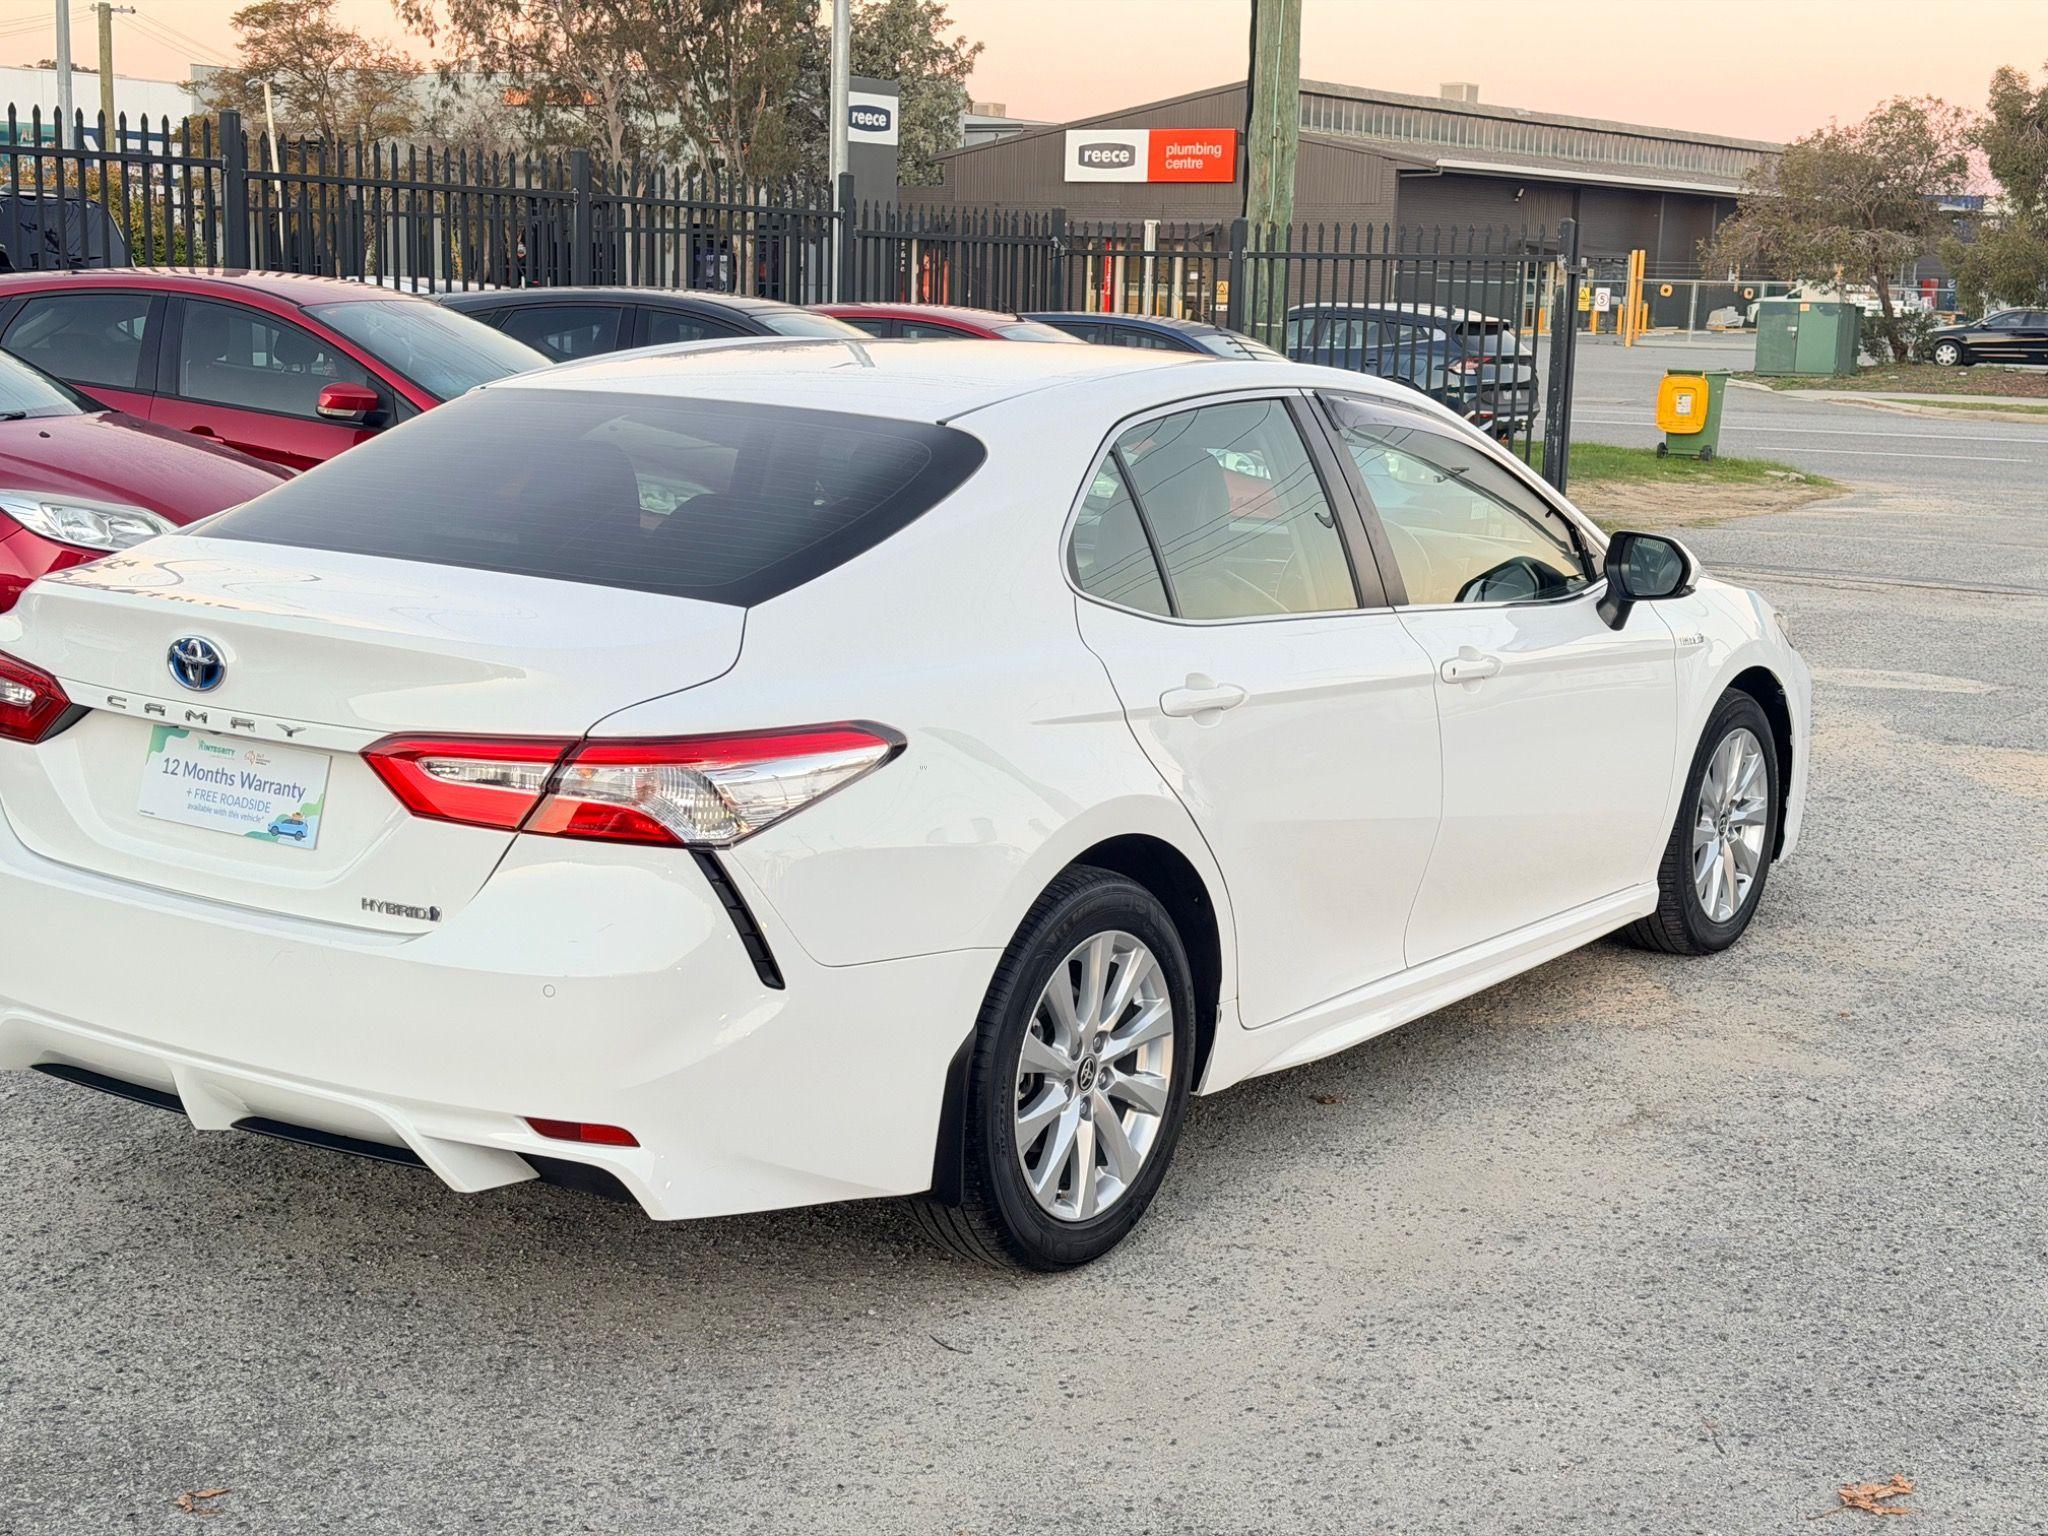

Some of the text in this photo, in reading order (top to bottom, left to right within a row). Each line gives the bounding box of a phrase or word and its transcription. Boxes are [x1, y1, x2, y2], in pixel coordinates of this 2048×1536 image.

[852, 111, 887, 127] reece
[1084, 149, 1130, 163] reece
[1166, 142, 1223, 158] plumbing
[1165, 158, 1204, 170] centre
[107, 695, 307, 737] CAMRY
[162, 757, 307, 802] 12 Months Warranty
[186, 788, 272, 814] + FREE ROADSIDE
[187, 802, 212, 815] available
[213, 806, 227, 817] with
[228, 808, 239, 819] this
[361, 897, 427, 920] HYBRID
